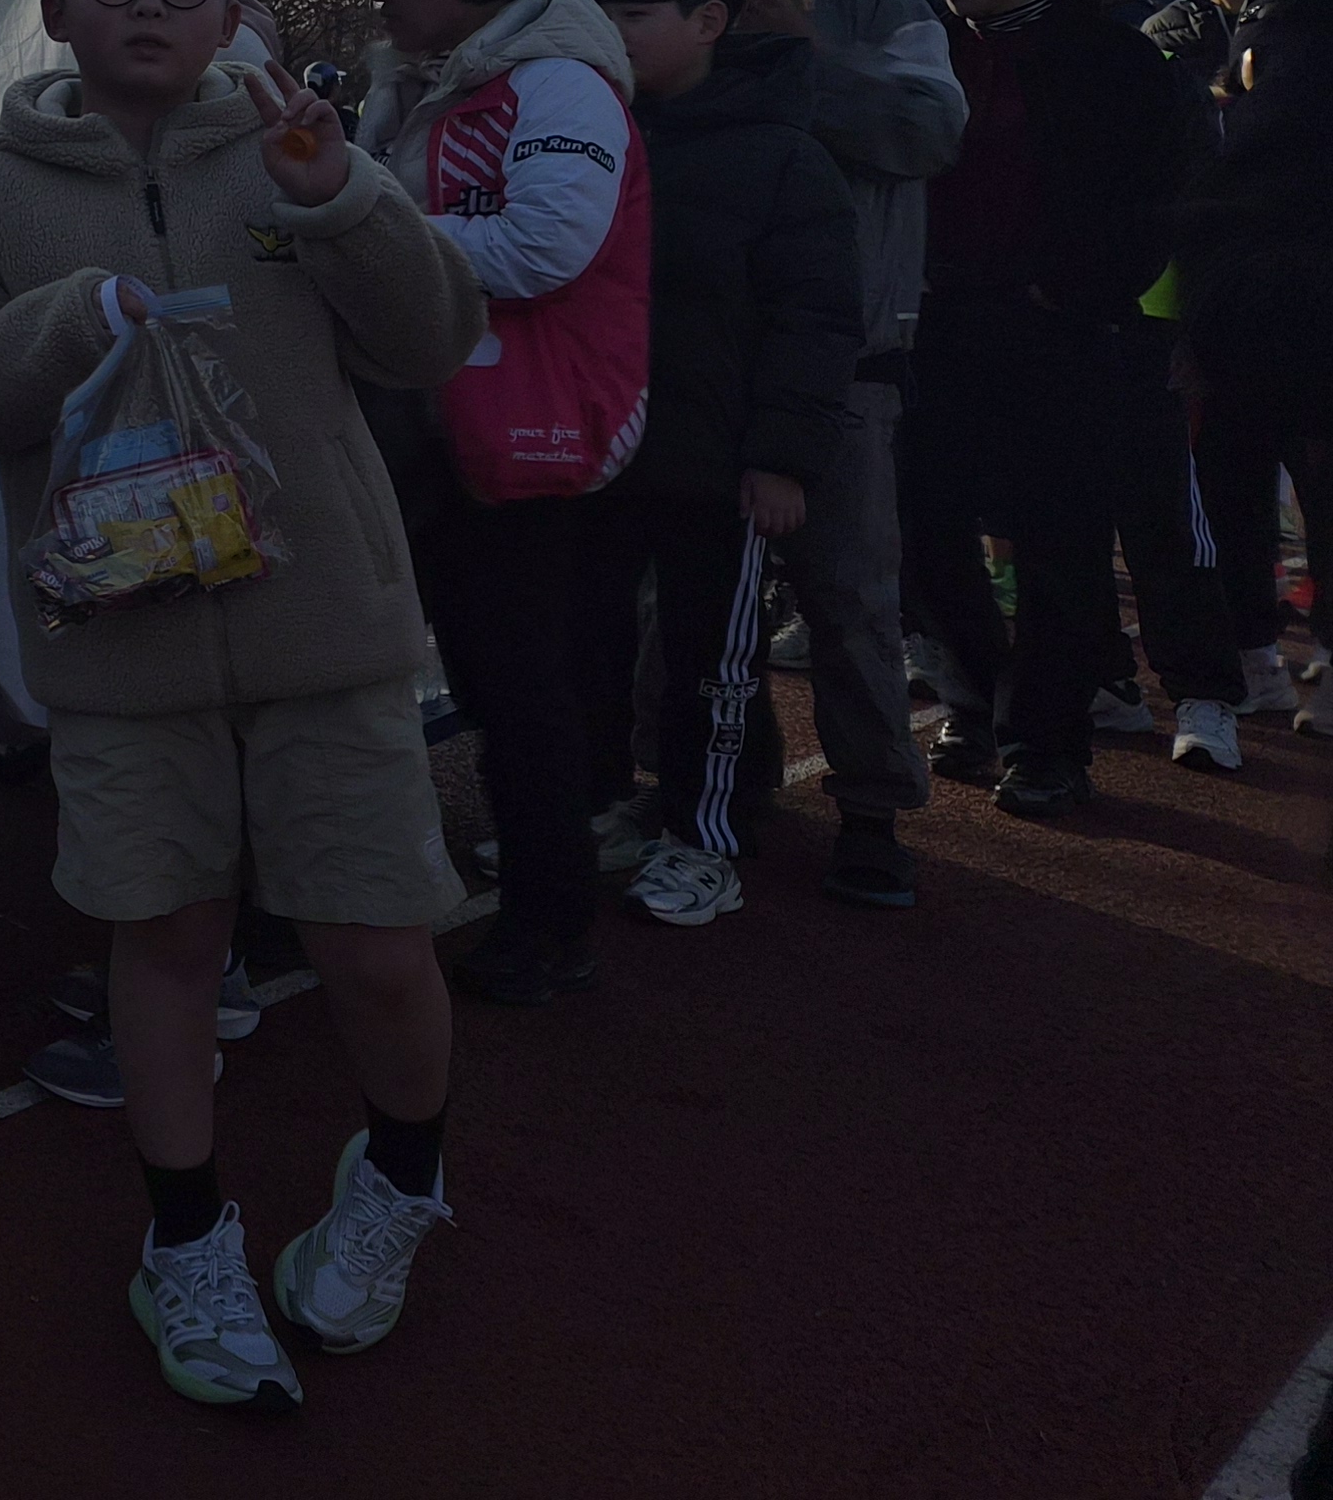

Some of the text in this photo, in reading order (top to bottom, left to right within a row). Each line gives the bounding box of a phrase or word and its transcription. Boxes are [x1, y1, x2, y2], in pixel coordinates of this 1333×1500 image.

[516, 137, 614, 172] HD Run Club
